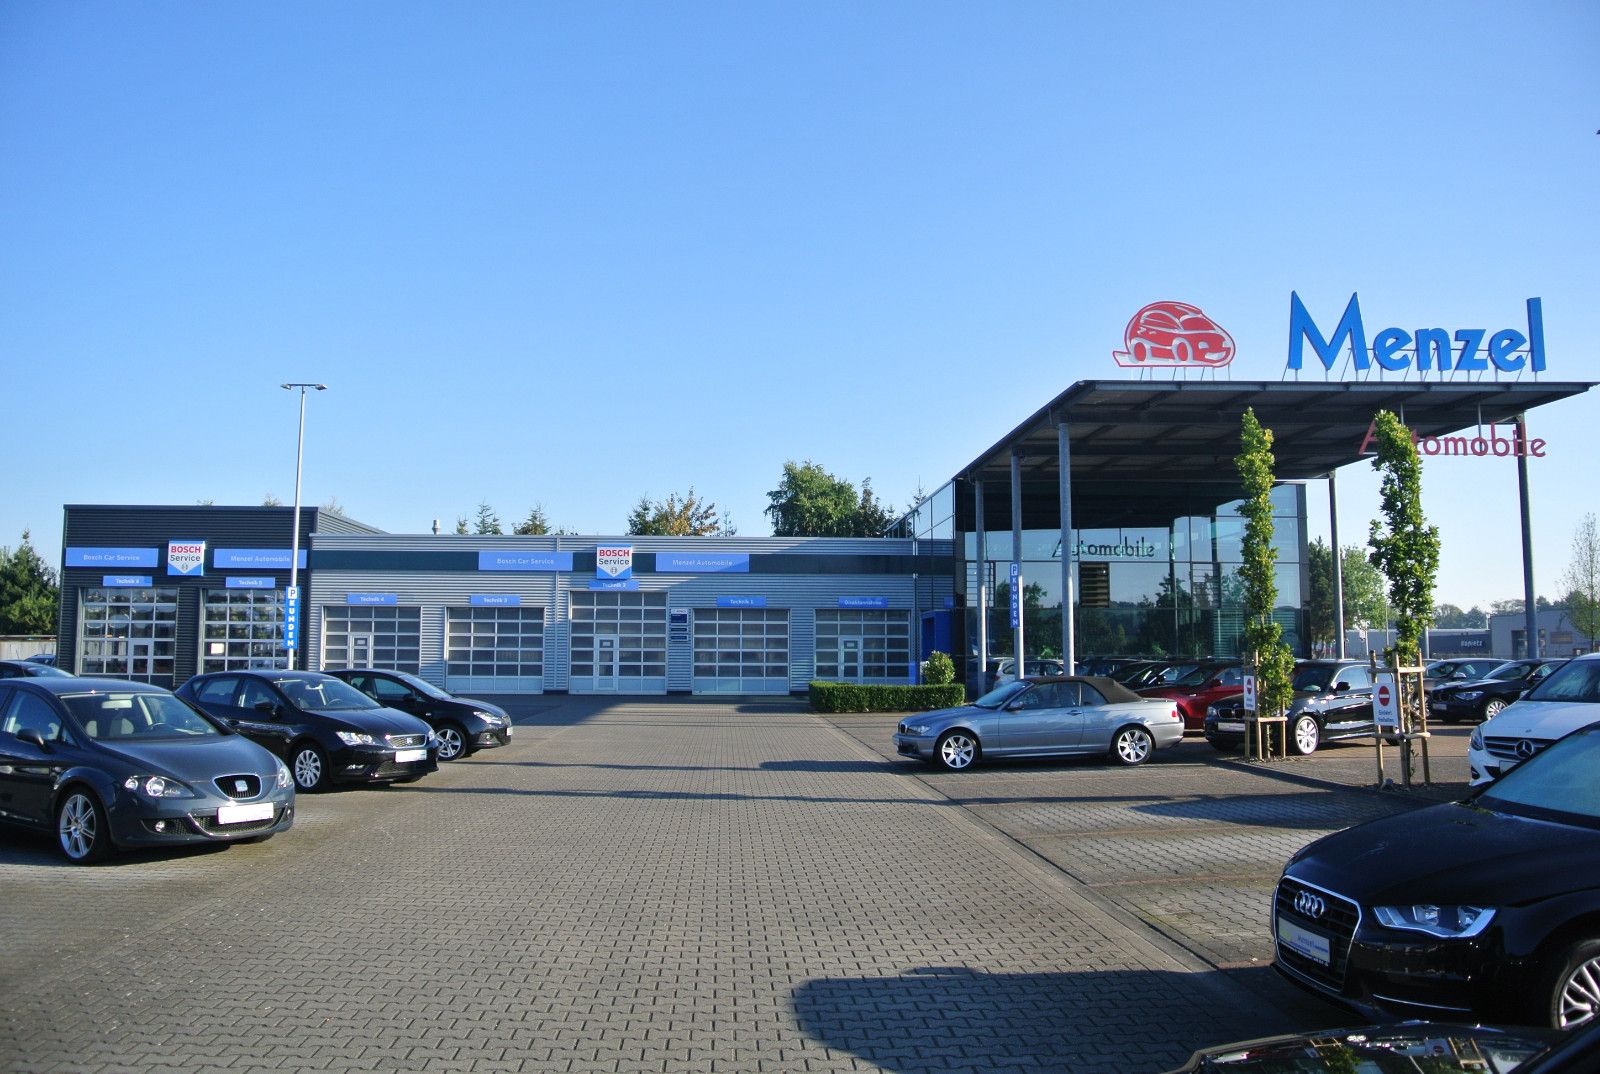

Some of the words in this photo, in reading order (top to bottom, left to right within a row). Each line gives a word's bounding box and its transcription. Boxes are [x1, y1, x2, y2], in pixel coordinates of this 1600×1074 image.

[1288, 290, 1546, 372] Menzel
[170, 545, 202, 554] BOSCH
[599, 549, 631, 557] BOSCH
[169, 554, 202, 562] Service
[530, 557, 555, 565] Service
[287, 600, 296, 647] KUNDEN
